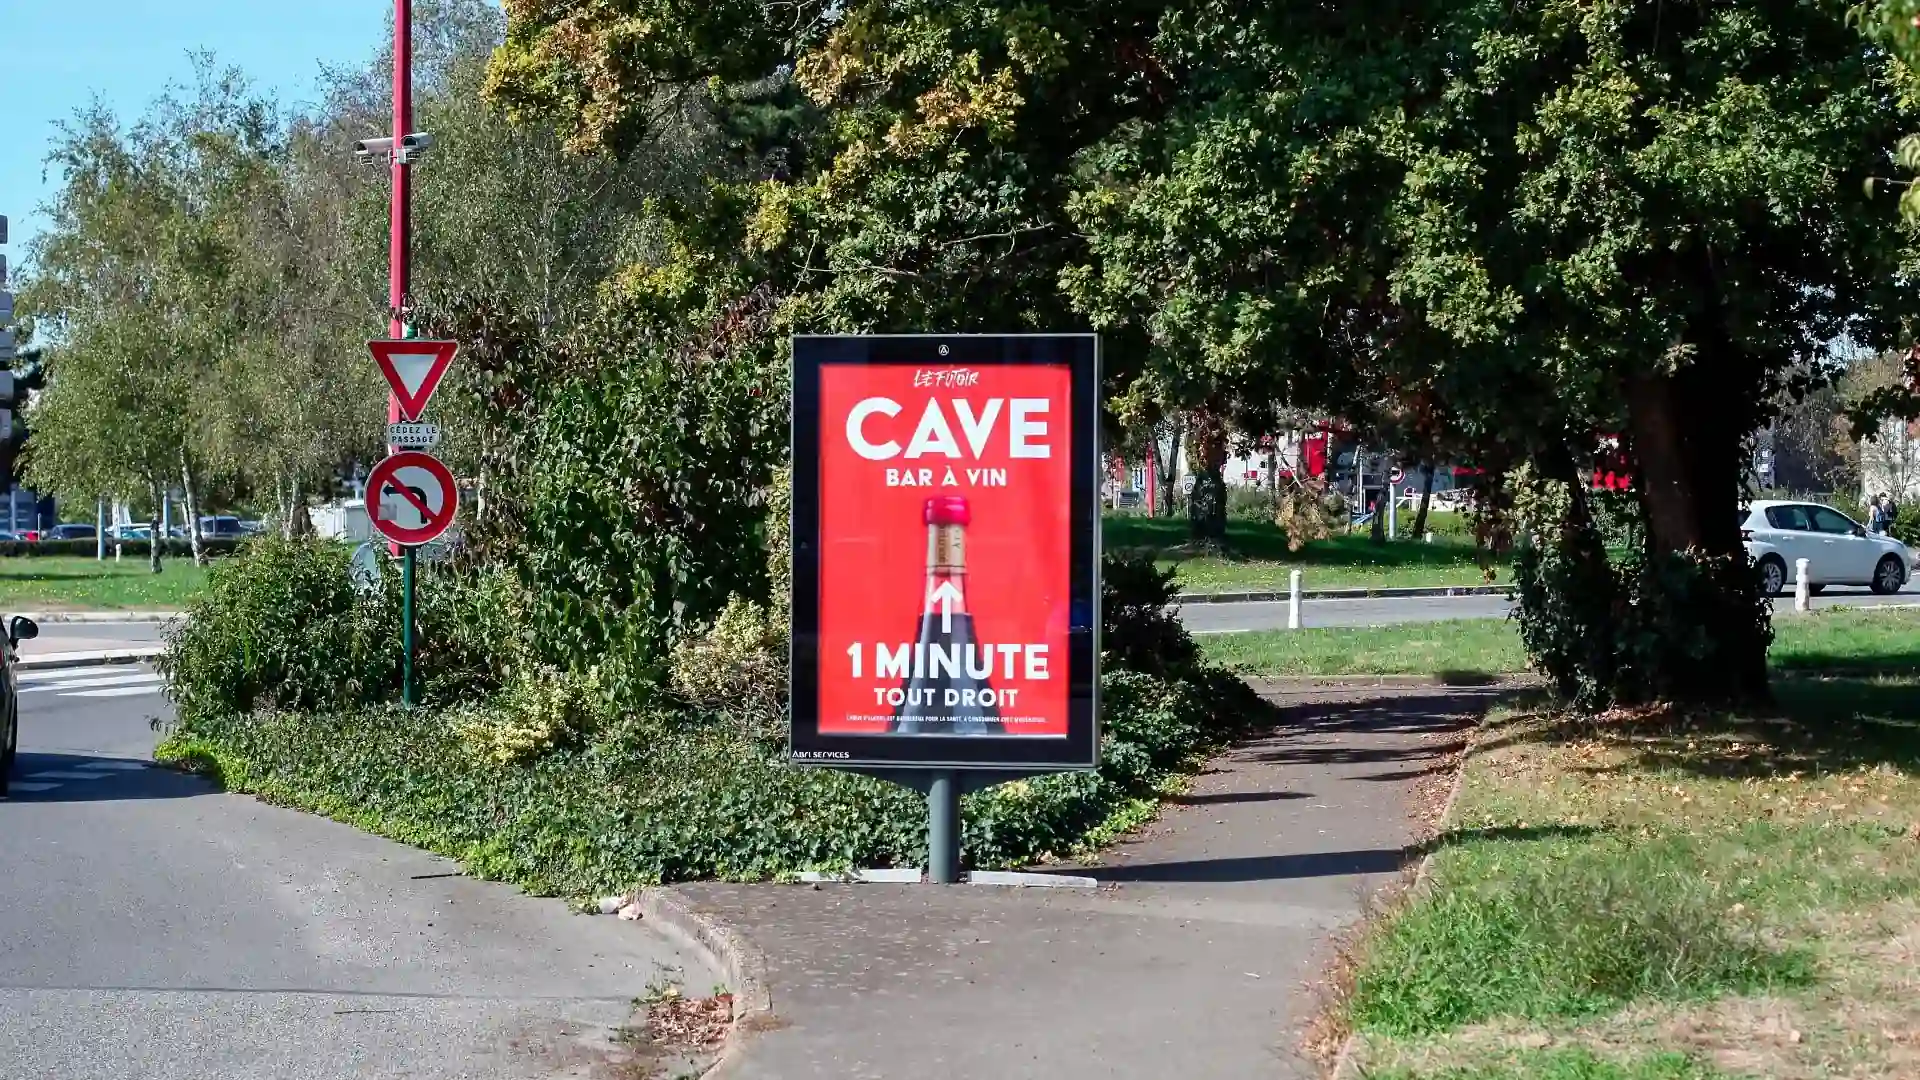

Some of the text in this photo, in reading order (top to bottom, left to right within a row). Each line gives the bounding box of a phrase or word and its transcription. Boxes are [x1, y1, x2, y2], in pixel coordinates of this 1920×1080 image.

[914, 367, 979, 388] LE FUTOIR
[390, 425, 437, 434] CÉDEZ LE
[392, 435, 433, 443] PASSAGE
[846, 397, 1051, 460] CAVE
[886, 465, 1007, 487] BAR À VIN
[847, 642, 1050, 680] 1 MINUTE
[874, 688, 1018, 707] TOUT DROIT
